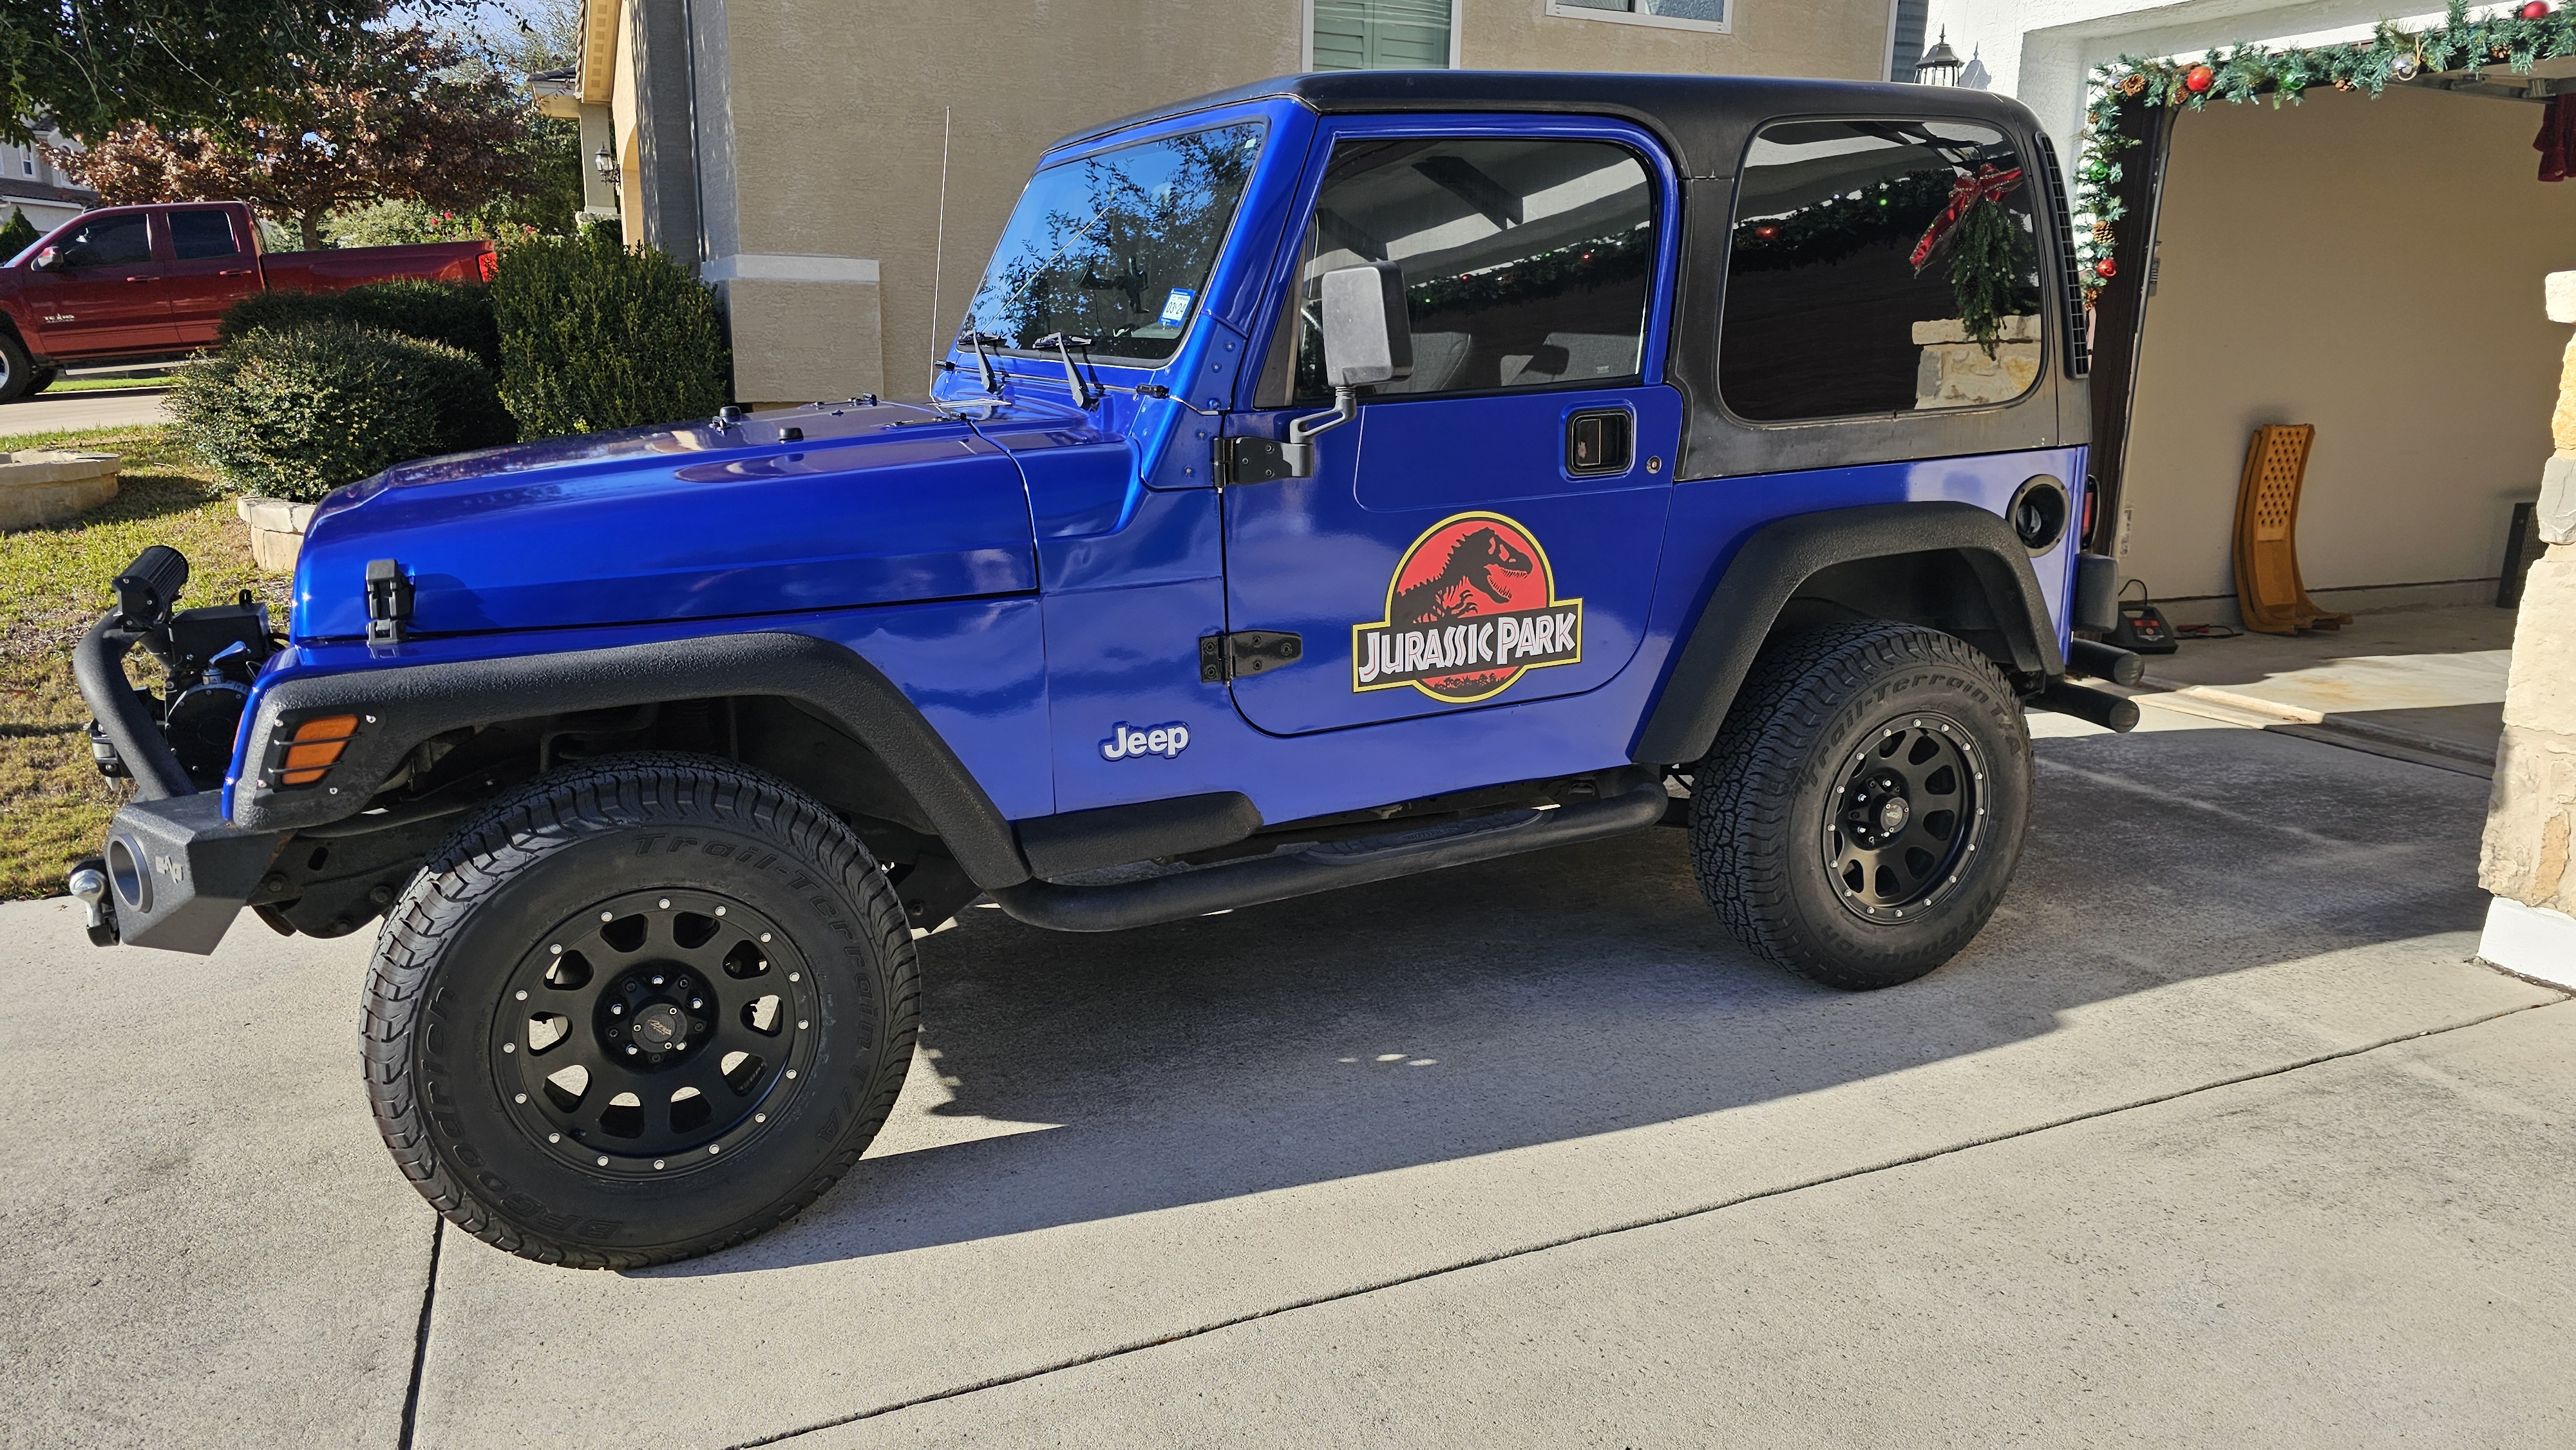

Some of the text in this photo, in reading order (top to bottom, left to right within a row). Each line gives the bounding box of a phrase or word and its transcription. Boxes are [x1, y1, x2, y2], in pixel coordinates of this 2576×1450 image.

[1358, 612, 1577, 683] JURASSIC PARK
[1103, 726, 1189, 759] Jeep
